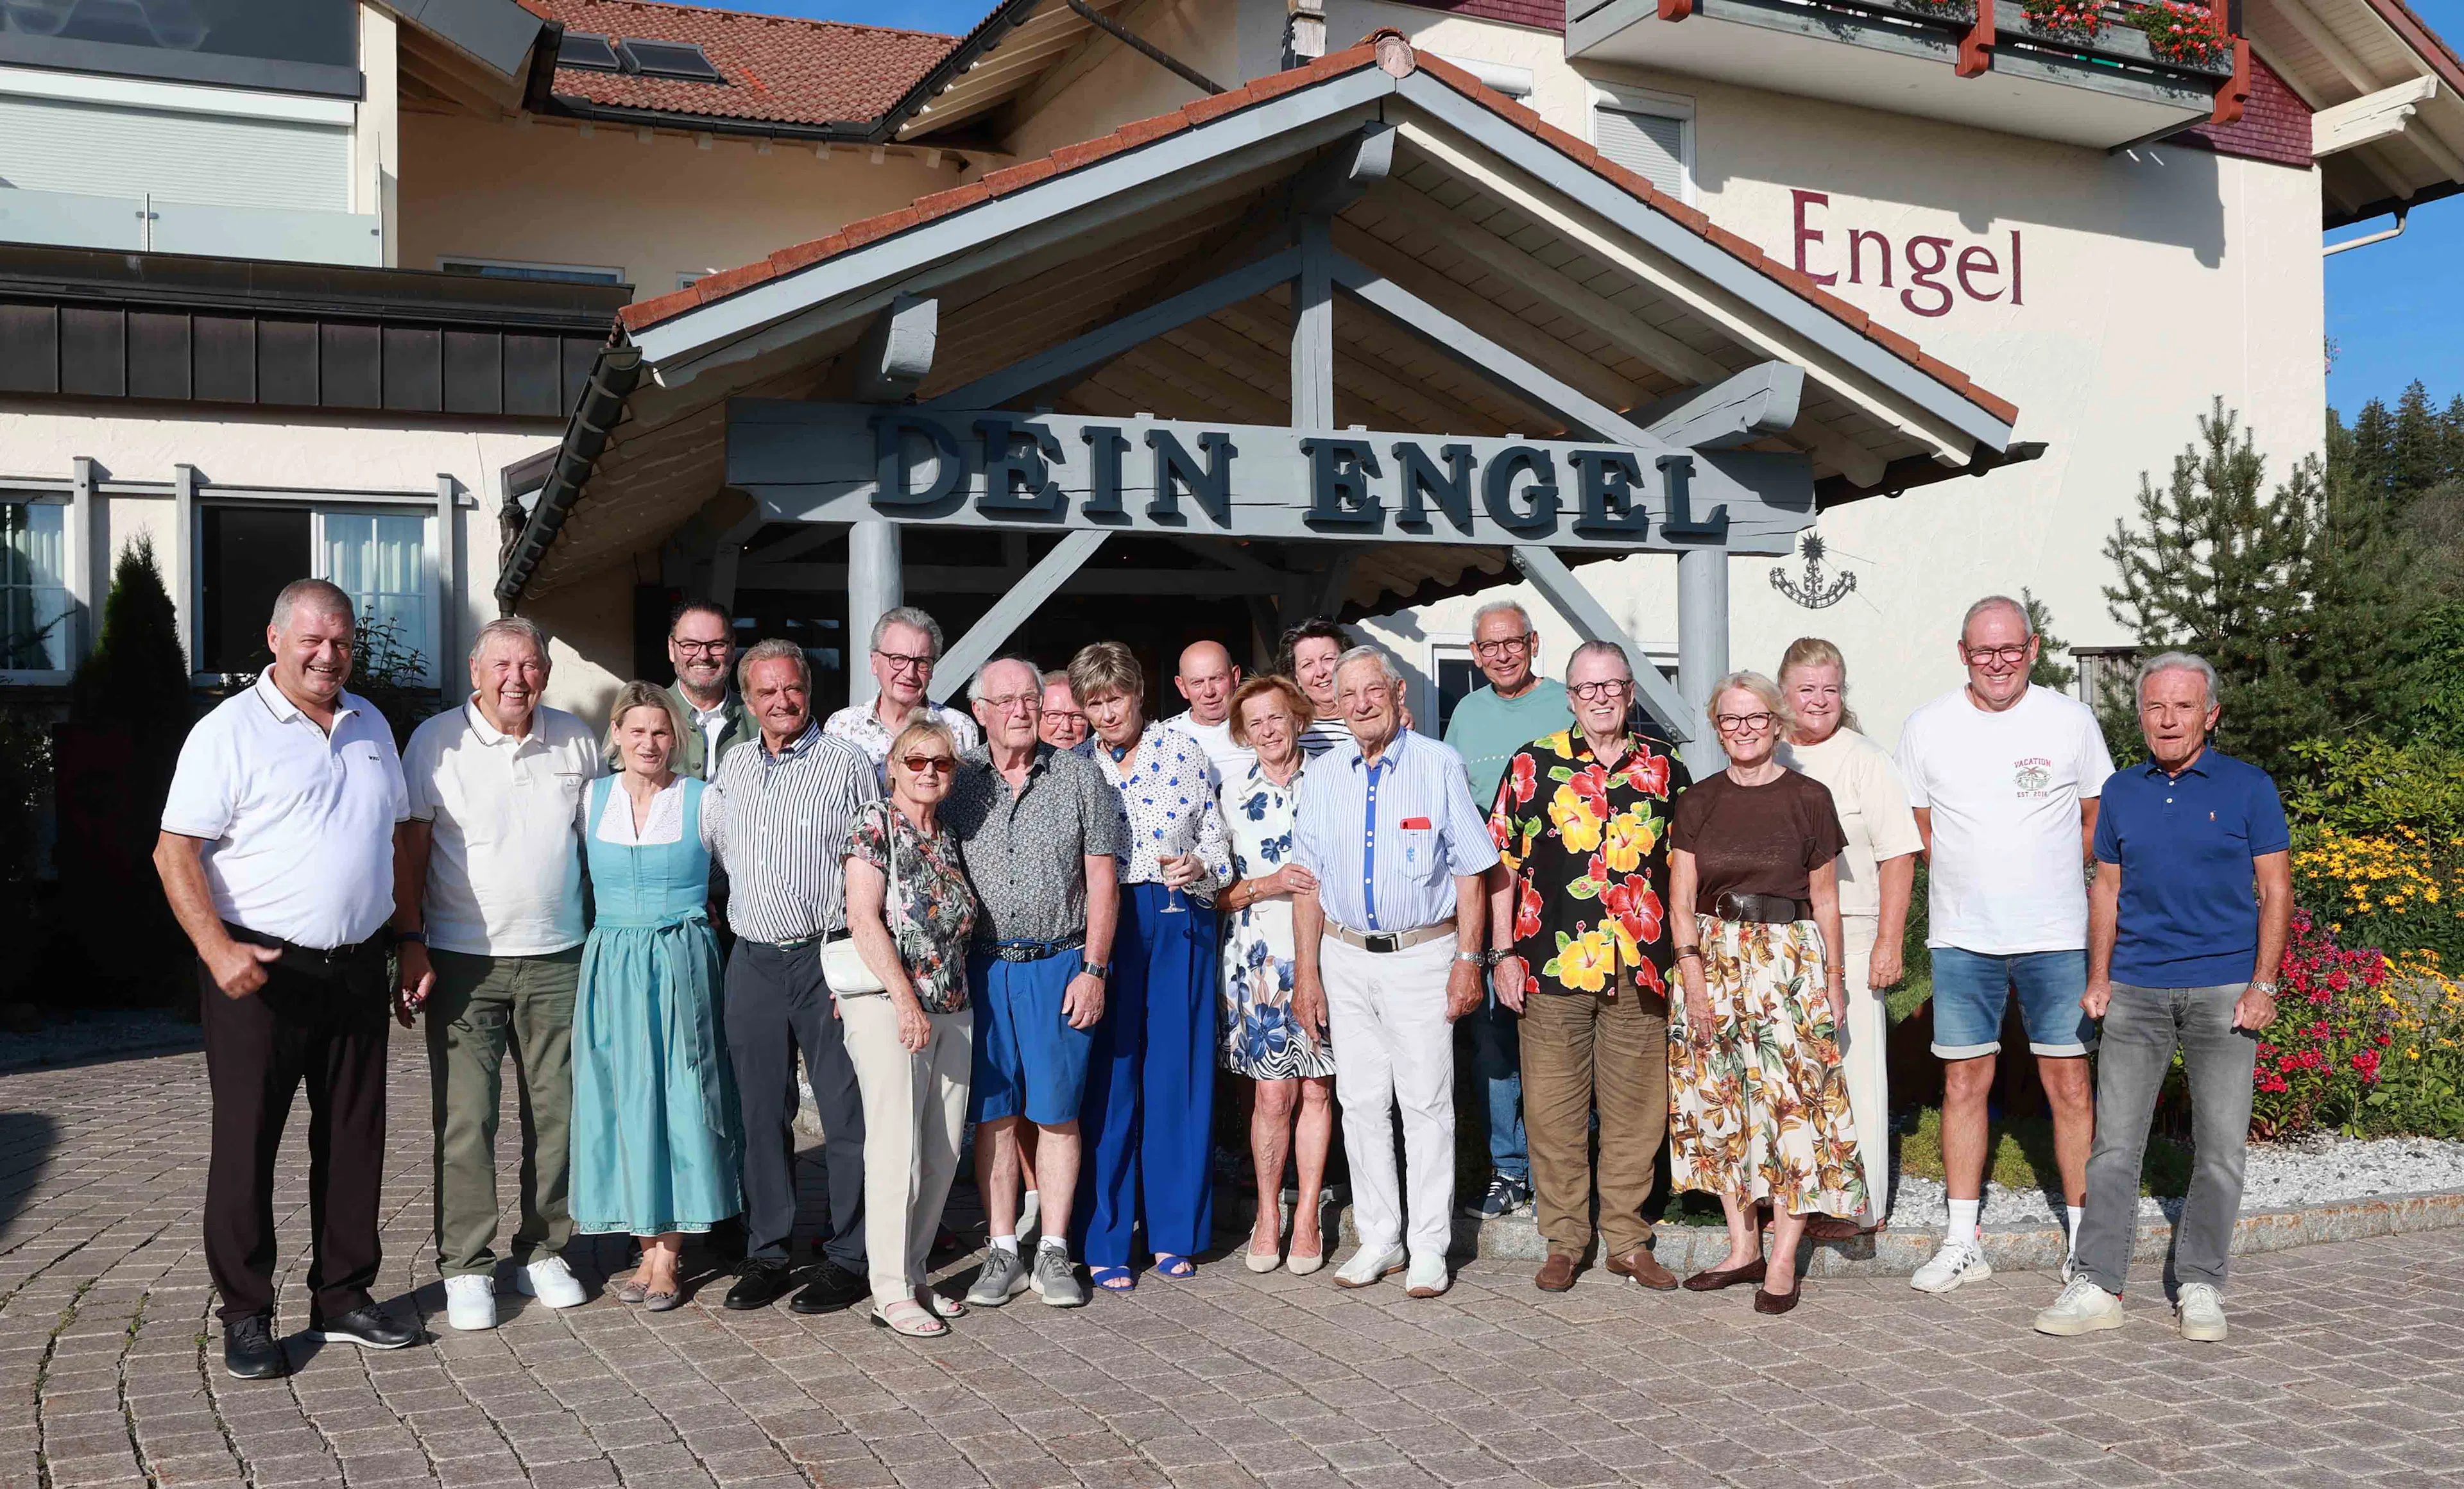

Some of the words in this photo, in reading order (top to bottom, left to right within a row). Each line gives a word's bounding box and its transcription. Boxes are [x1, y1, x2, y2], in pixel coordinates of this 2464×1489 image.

[1790, 189, 2024, 317] Engel
[868, 416, 1233, 522] DEIN
[1299, 438, 1727, 536] ENGEL
[2014, 758, 2051, 769] VACATION
